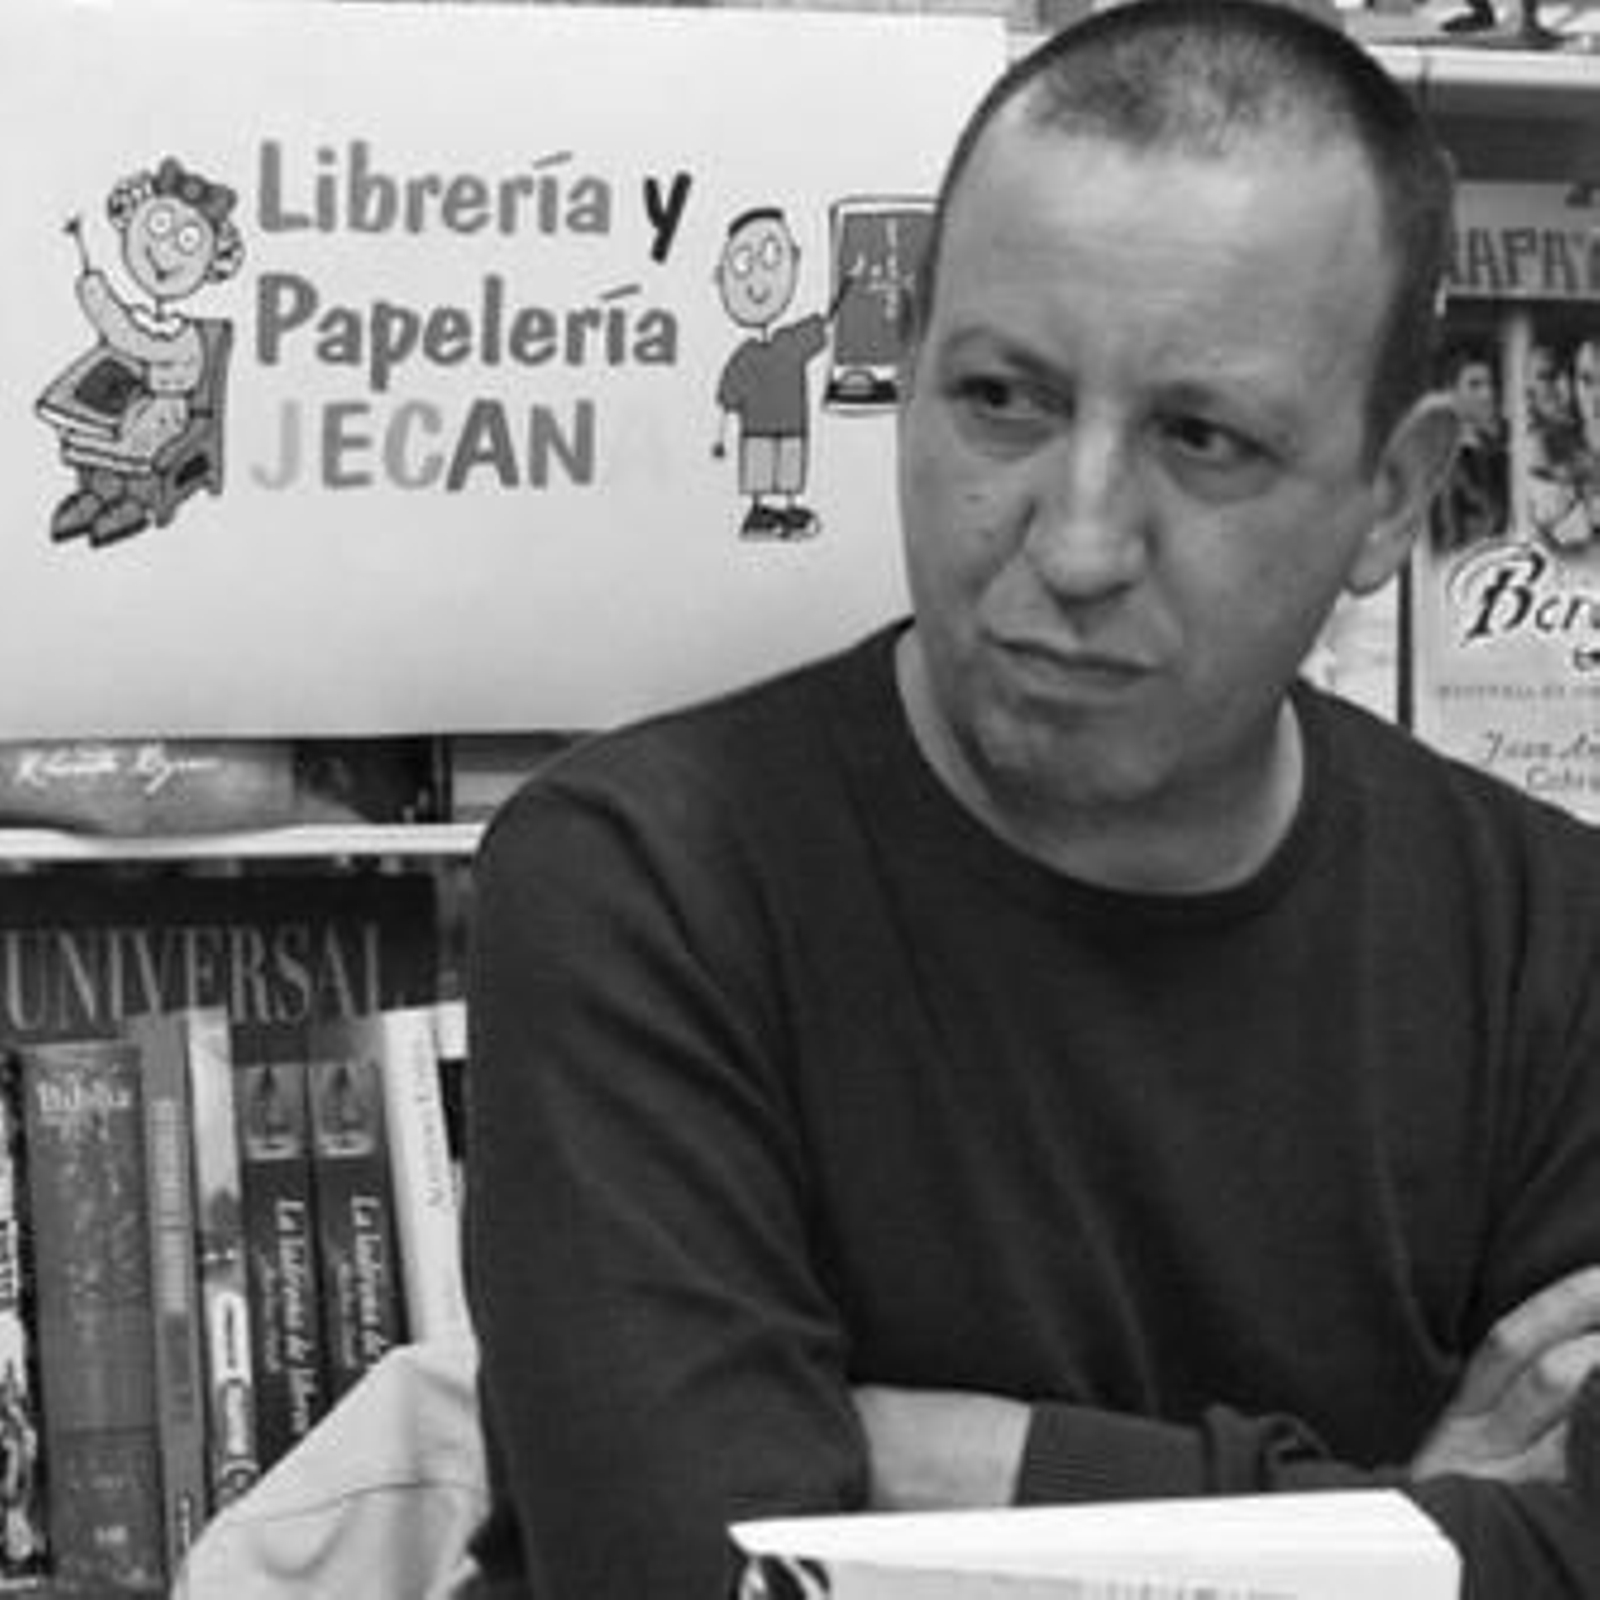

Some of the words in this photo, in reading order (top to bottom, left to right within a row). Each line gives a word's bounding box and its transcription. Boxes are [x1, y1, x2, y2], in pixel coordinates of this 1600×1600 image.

[258, 141, 610, 235] Librería
[643, 171, 693, 265] y
[256, 273, 678, 392] Papelería
